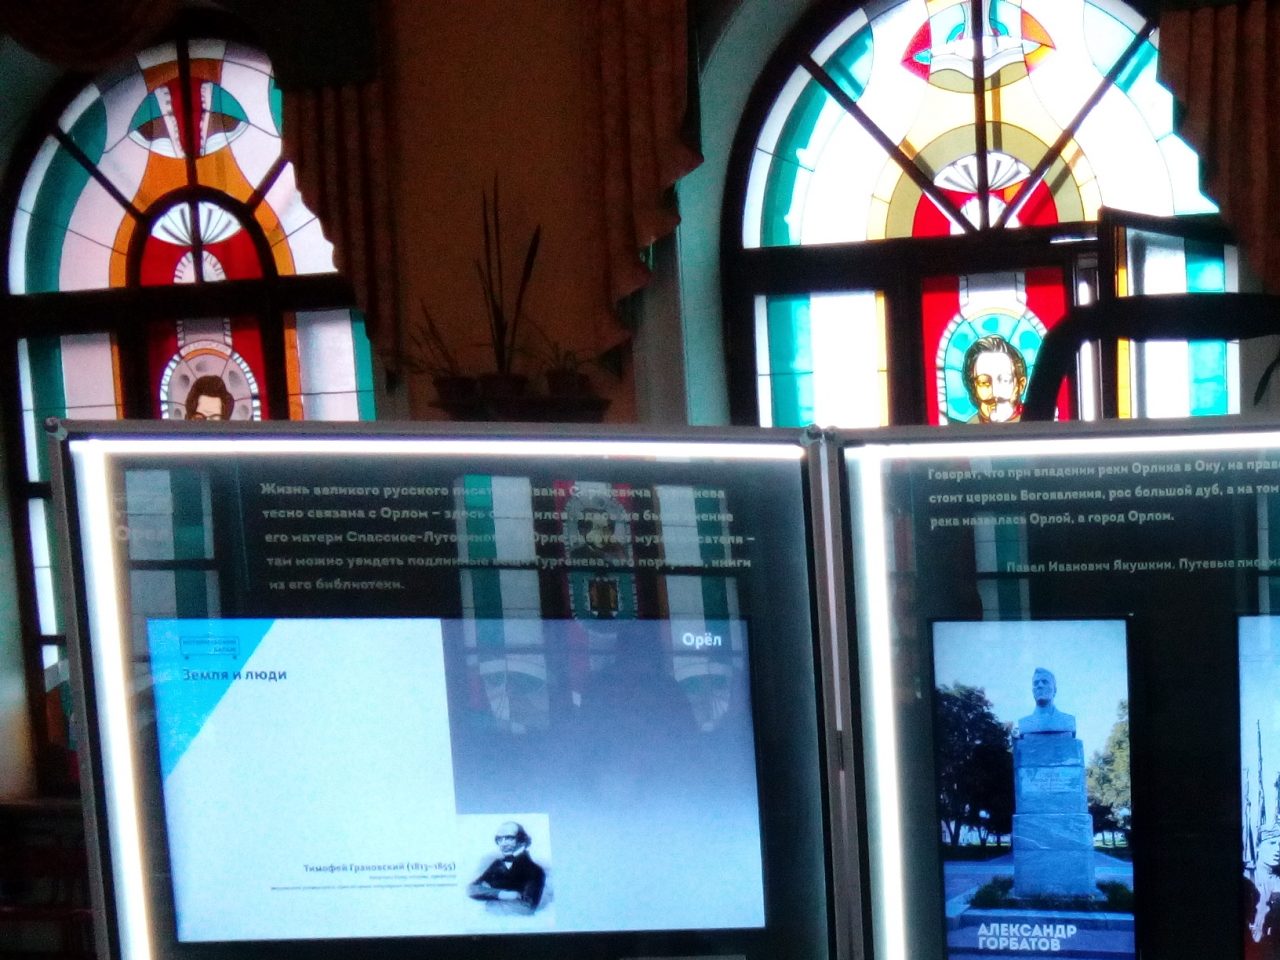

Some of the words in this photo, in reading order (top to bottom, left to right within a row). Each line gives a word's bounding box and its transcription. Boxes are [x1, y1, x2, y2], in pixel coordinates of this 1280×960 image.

[928, 467, 982, 483] Говорят,
[1008, 466, 1031, 481] при
[1034, 464, 1095, 477] впадении
[1098, 463, 1128, 478] реки
[1132, 460, 1181, 477] Орлика
[1195, 458, 1225, 474] Оку,
[260, 482, 310, 495] Жизнь
[313, 485, 380, 496] великого
[383, 485, 449, 500] русского
[929, 492, 964, 503] стоит
[966, 490, 1017, 505] церковь
[1020, 487, 1106, 502] Богоявления,
[1108, 487, 1132, 501] рос
[1134, 482, 1192, 497] большой
[1195, 481, 1224, 499] дуб,
[1256, 483, 1279, 494] том
[261, 508, 304, 519] тесно
[307, 508, 366, 519] связана
[379, 506, 429, 523] Орлом
[444, 509, 485, 521] здесь
[929, 515, 959, 530] река
[962, 514, 1027, 526] назвалась
[1029, 510, 1075, 528] Орлой,
[1088, 512, 1125, 526] город
[1128, 509, 1175, 526] Орлом.
[264, 533, 288, 543] его
[291, 533, 343, 547] матери
[266, 557, 292, 567] там
[295, 557, 343, 567] можно
[346, 557, 404, 571] увидеть
[407, 557, 489, 569] подлинные
[535, 554, 609, 571] Тургенева,
[612, 557, 635, 568] его
[711, 557, 752, 568] книги
[1006, 560, 1045, 573] Павел
[1048, 559, 1110, 572] Иванович
[1113, 557, 1175, 574] Якушкин.
[1179, 556, 1235, 572] Путевые
[288, 581, 312, 591] его
[315, 578, 404, 591] библиотеки.
[682, 633, 722, 649] Орёл
[181, 669, 228, 681] Земля
[233, 671, 241, 680] и
[245, 670, 287, 682] люди
[303, 864, 348, 874] Тимофей
[350, 863, 405, 874] Грановский
[977, 923, 1078, 938] АЛЕКСАНДР
[978, 937, 1061, 951] ГОРБАТОВ
